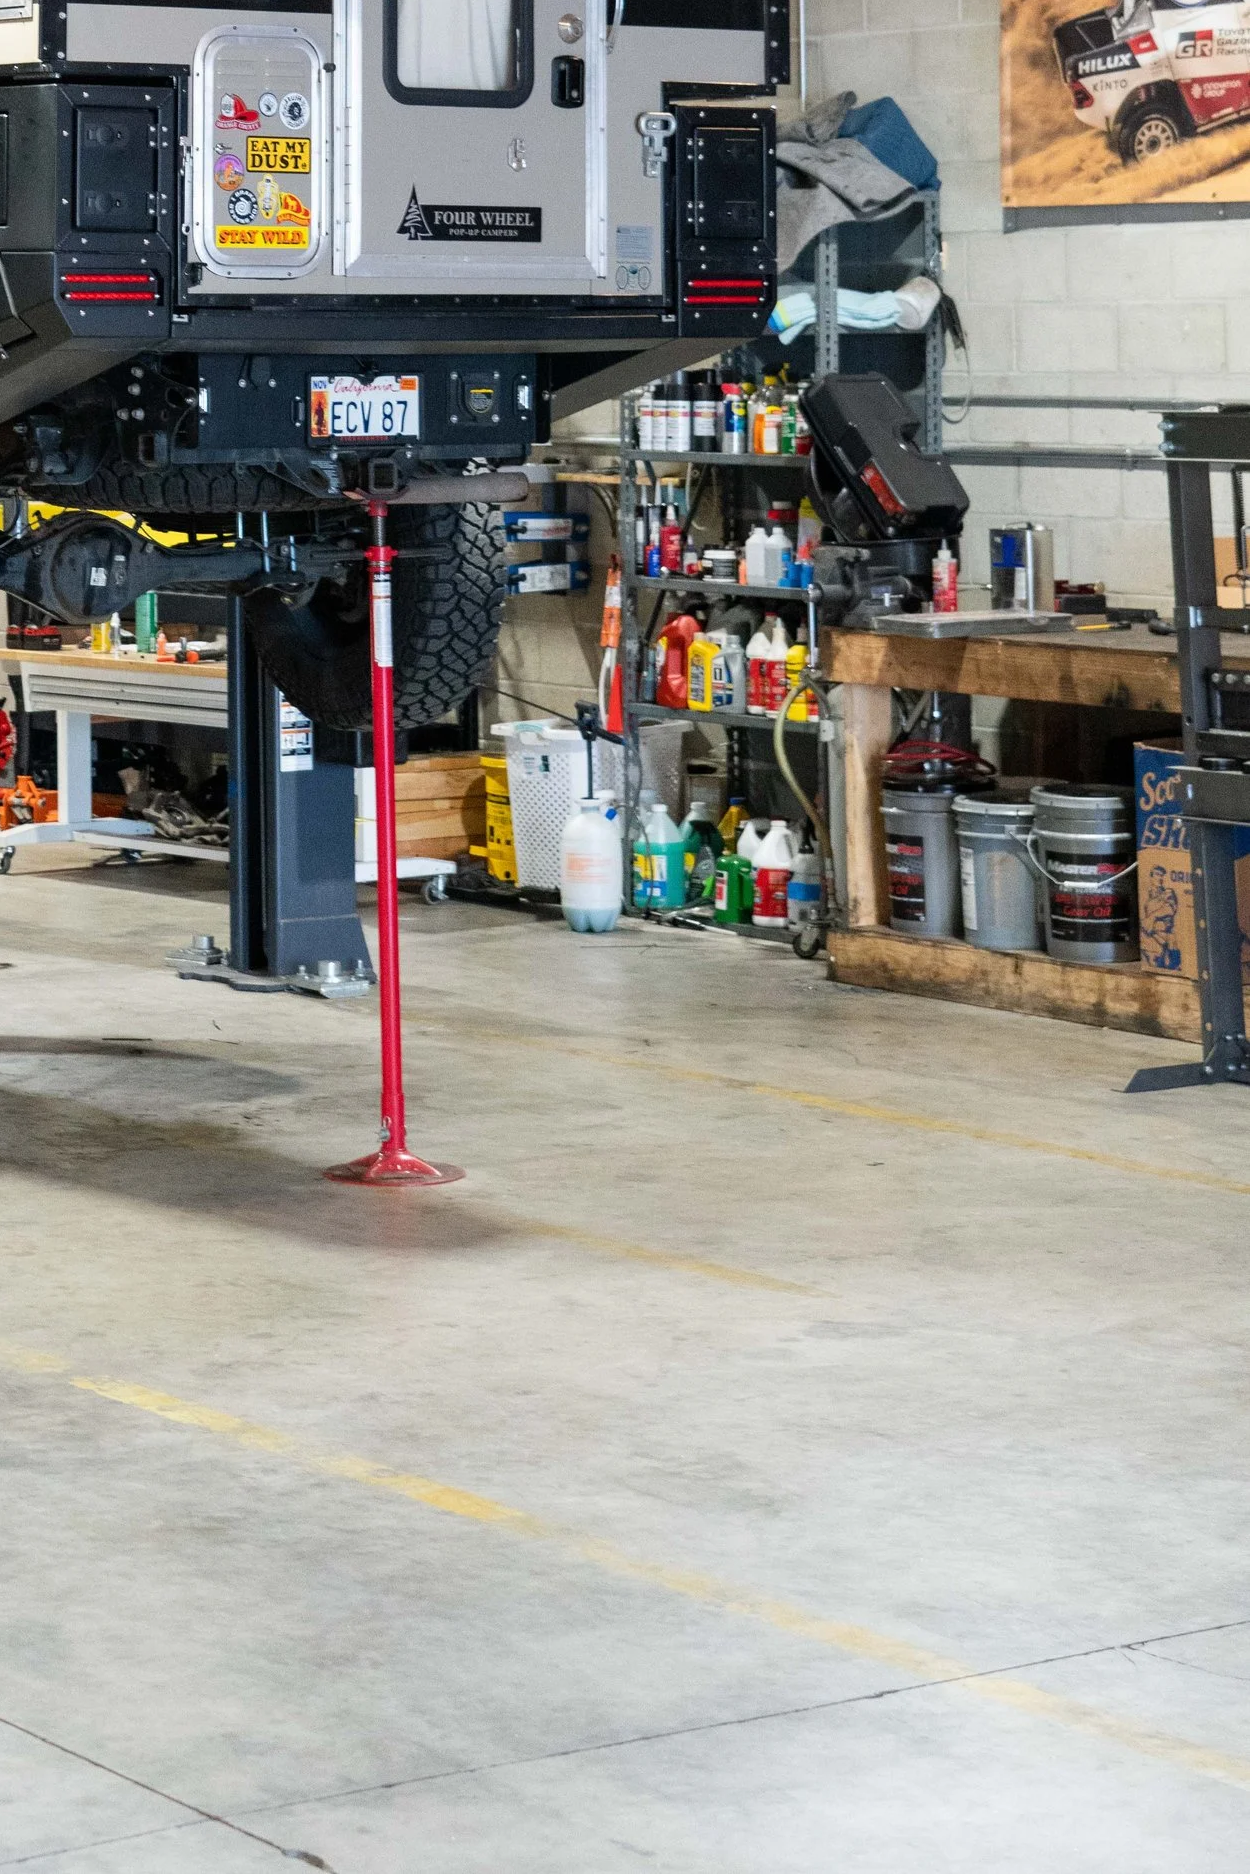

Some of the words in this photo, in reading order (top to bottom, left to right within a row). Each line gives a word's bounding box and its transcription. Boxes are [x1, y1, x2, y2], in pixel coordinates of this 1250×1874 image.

[1177, 39, 1213, 58] GR
[1078, 52, 1134, 75] HILUX
[250, 140, 280, 153] EAT
[285, 141, 307, 154] MY
[433, 210, 476, 226] FOUR
[480, 211, 535, 227] WHEEL
[219, 230, 259, 244] STAY
[449, 227, 479, 236] POP-UP
[480, 228, 519, 237] CAMPERS
[312, 381, 328, 390] NOV
[331, 400, 372, 434] ECV
[382, 400, 409, 434] 87
